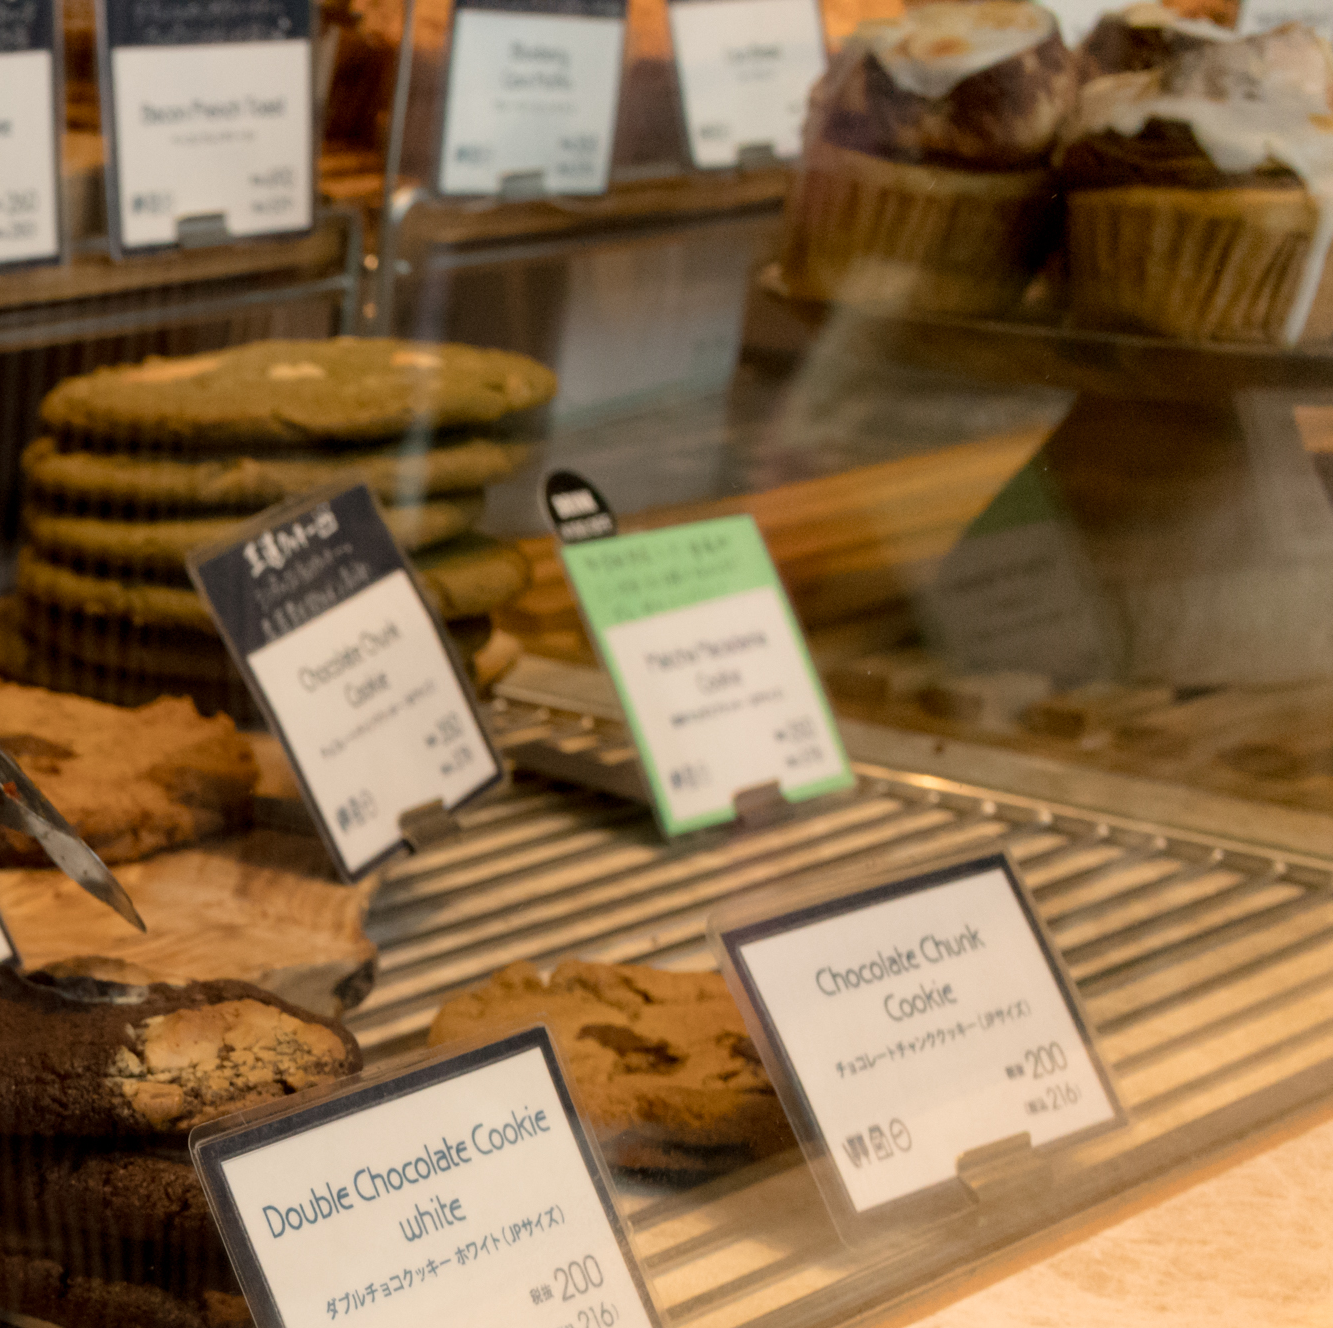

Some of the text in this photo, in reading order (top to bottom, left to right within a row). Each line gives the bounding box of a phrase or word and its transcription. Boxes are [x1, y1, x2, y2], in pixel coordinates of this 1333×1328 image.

[815, 923, 986, 997] Chocolate Chunk
[883, 979, 958, 1023] Cookie
[1024, 1040, 1068, 1080] 200
[262, 1105, 551, 1238] Double Chocolate Cookie
[399, 1195, 467, 1243] white
[326, 1257, 452, 1320] ダブルチョコクッキー
[553, 1254, 604, 1302] 200
